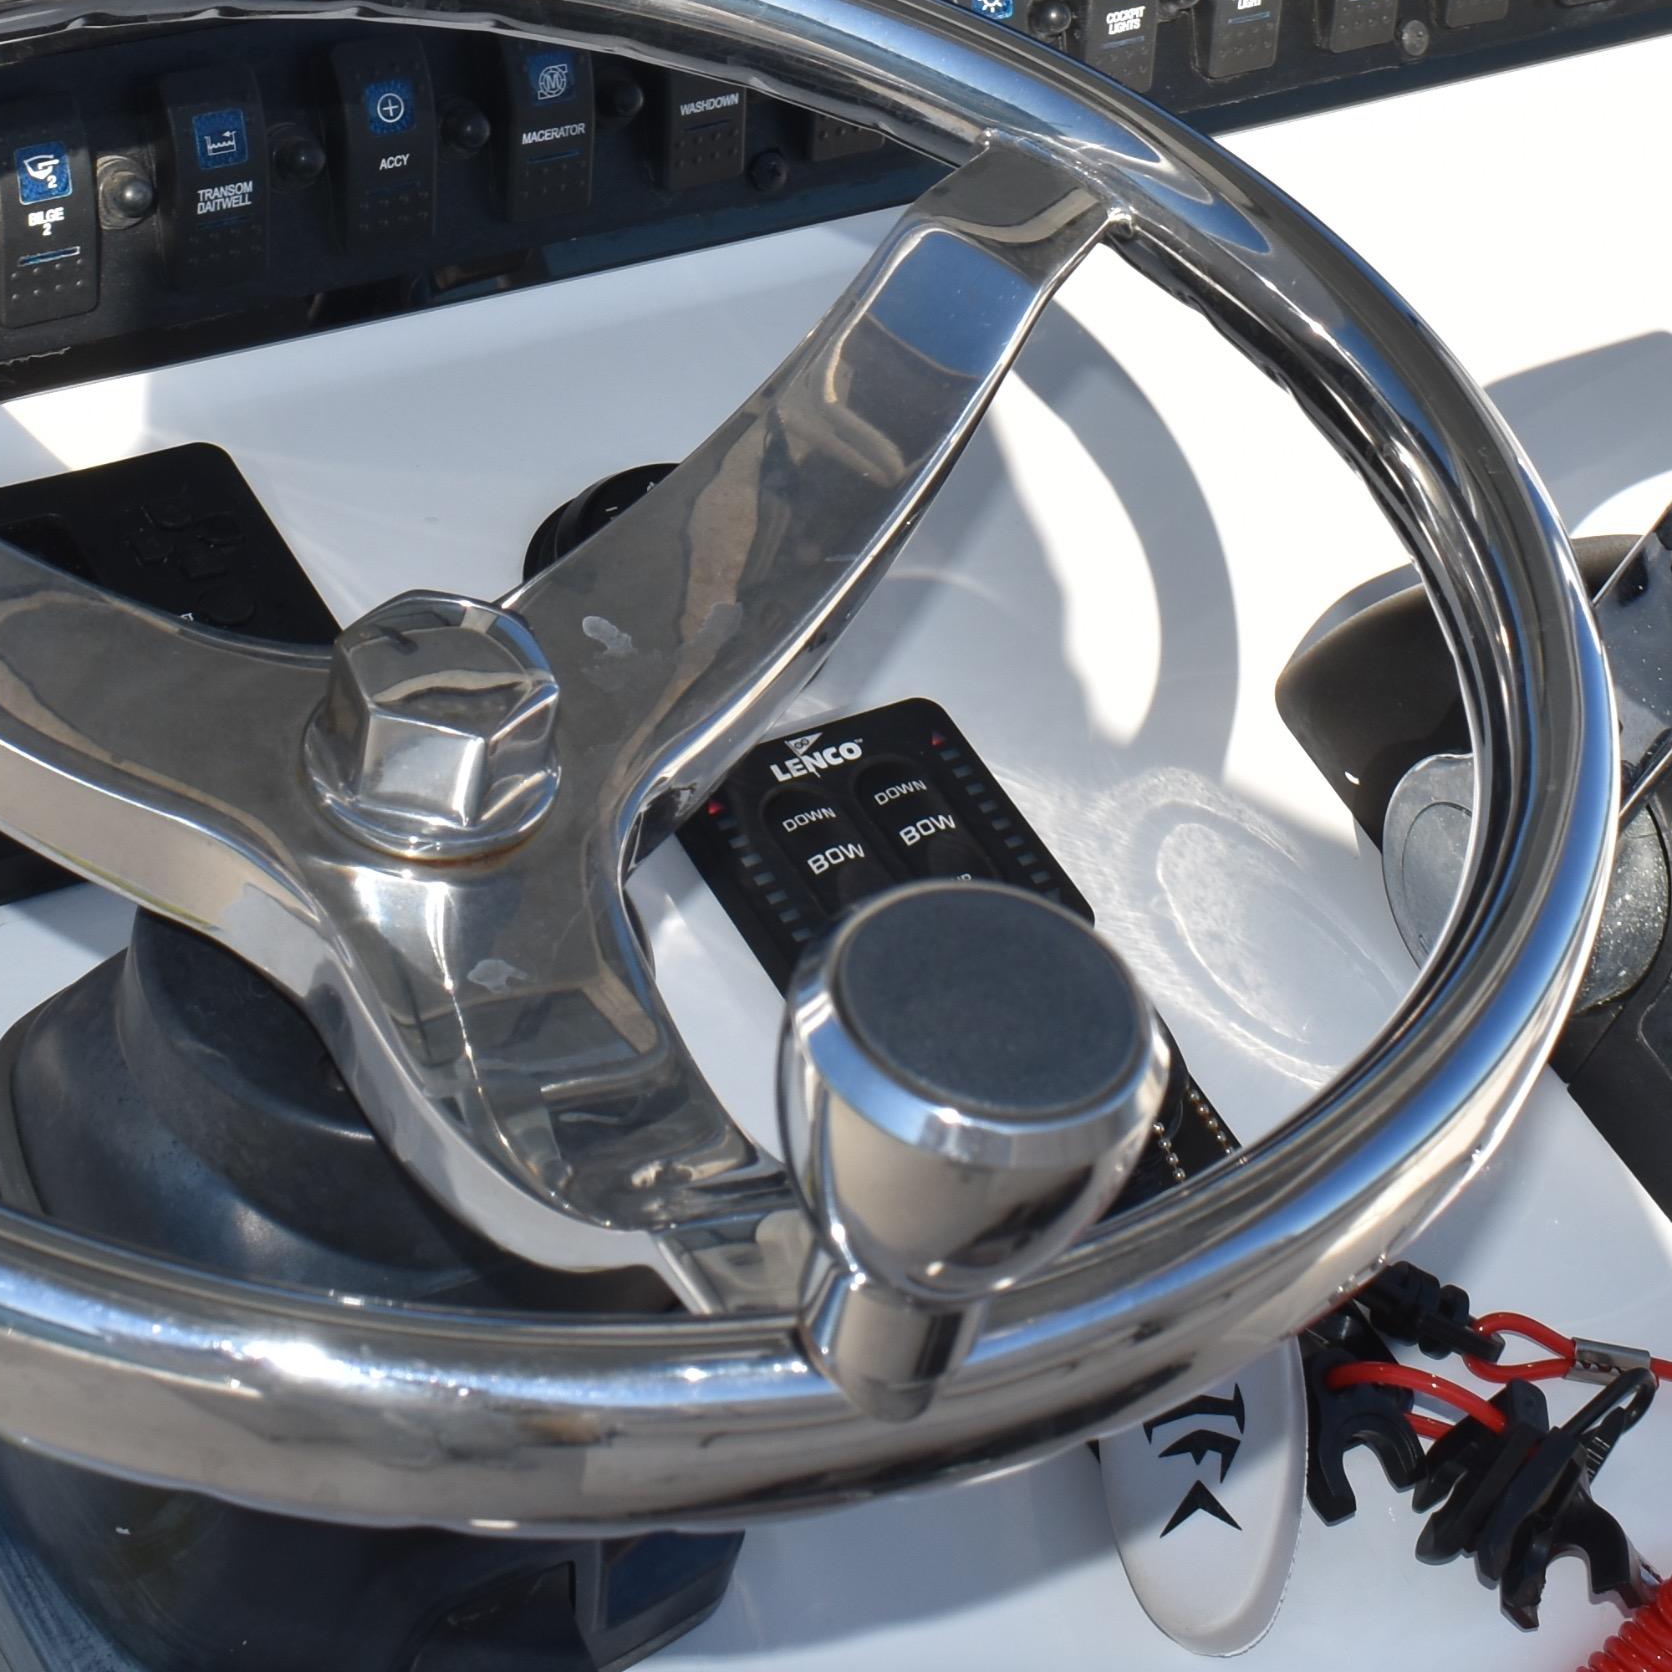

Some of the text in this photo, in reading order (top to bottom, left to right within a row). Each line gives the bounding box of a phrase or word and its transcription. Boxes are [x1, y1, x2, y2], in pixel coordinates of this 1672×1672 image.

[1106, 5, 1146, 24] COCKPIT
[1108, 18, 1141, 35] LIGHTS
[679, 93, 739, 117] WASHDOWN
[521, 122, 586, 145] MACERATOR
[379, 153, 411, 171] ACCY
[197, 180, 253, 201] TRANSOM
[28, 206, 65, 227] BILGE
[873, 779, 928, 806] DOWN
[781, 807, 837, 833] DOWN
[898, 814, 957, 847] BOW
[807, 843, 866, 875] BOW
